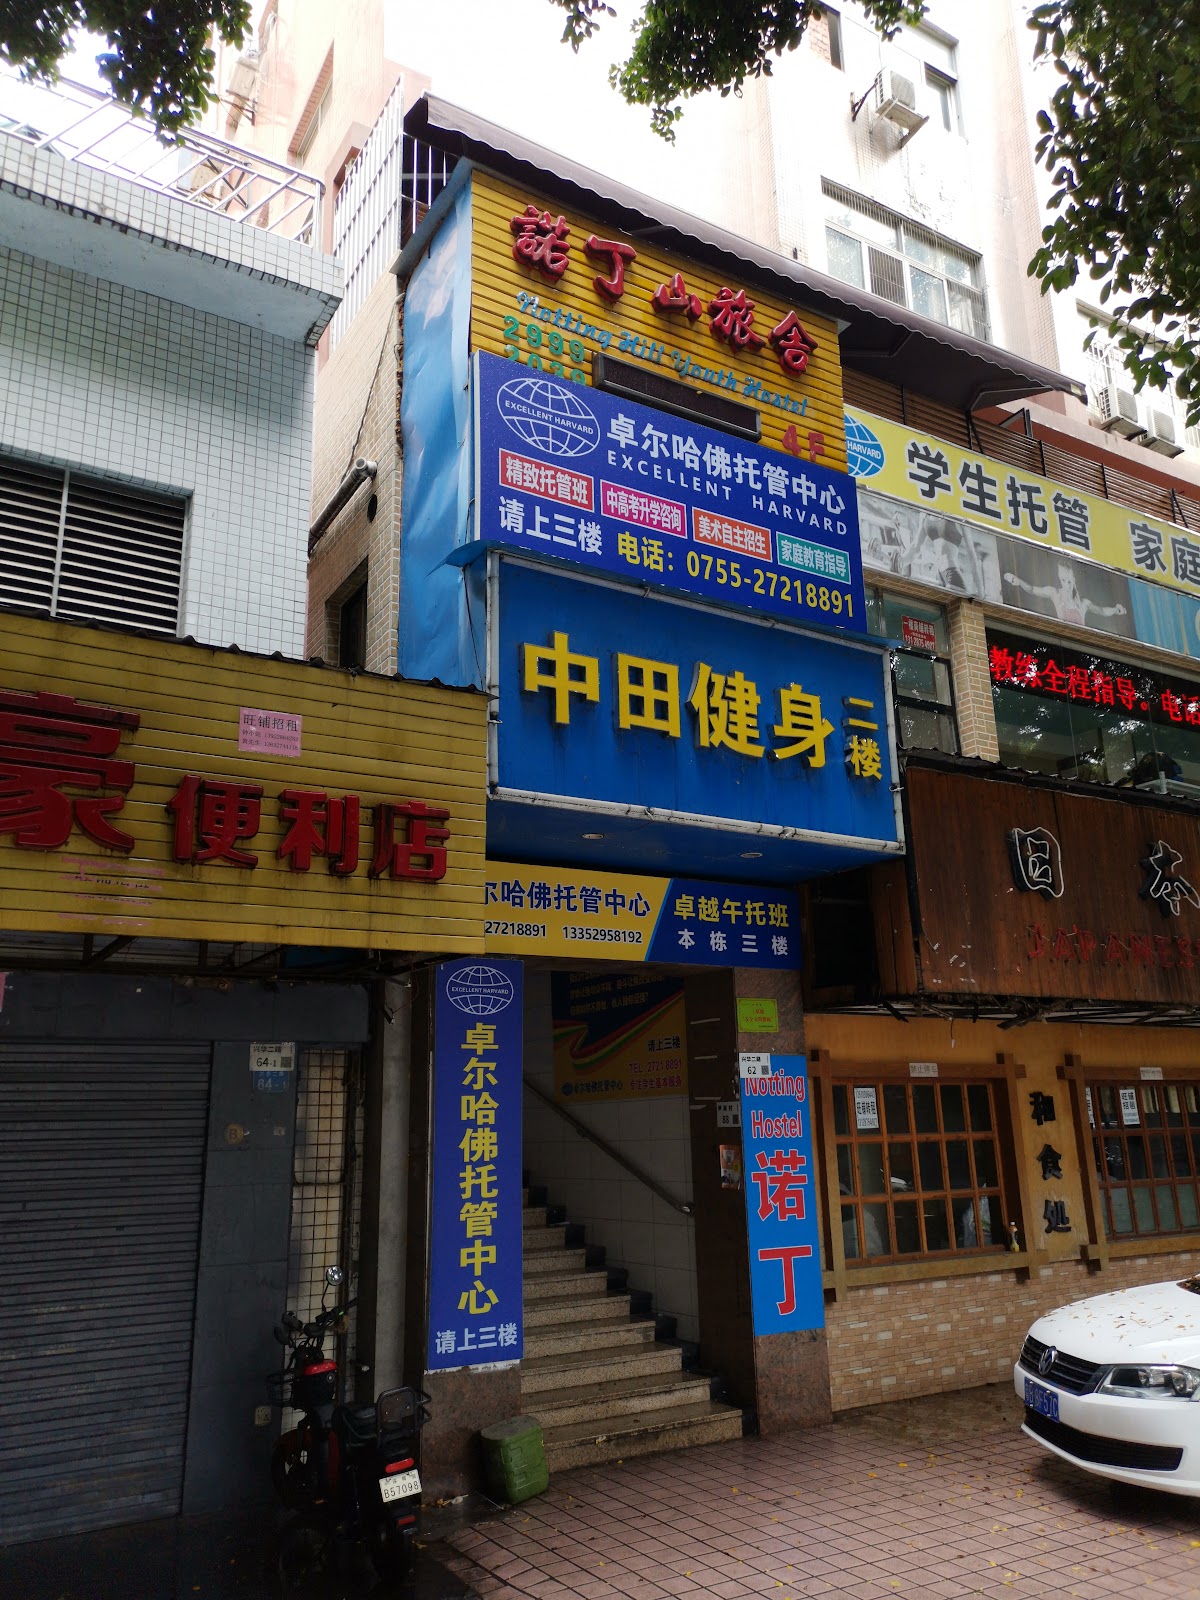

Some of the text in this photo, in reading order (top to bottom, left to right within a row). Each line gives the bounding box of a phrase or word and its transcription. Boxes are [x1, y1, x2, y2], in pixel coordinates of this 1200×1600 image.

[503, 315, 585, 363] 2999
[517, 290, 810, 417] Notting Hill Youth Hostel
[504, 399, 594, 437] EXCELLENT HARVARD
[606, 412, 847, 516] 卓尔哈佛托管中心
[781, 424, 826, 463] 4F
[847, 440, 882, 460] HARVARD
[505, 455, 589, 506] 精致托管班
[607, 449, 848, 536] EXCELLENT HARVARD
[905, 440, 1093, 551] 学生托管
[498, 495, 603, 556] 请上三楼
[606, 486, 682, 532] 中高考升学咨询
[698, 513, 768, 556] 美术自主招生
[780, 538, 848, 578] 家庭教育指导
[520, 629, 835, 769] 中田健身
[243, 714, 298, 732] 旺铺招租
[844, 696, 883, 781] 二楼
[167, 773, 451, 882] 便利店
[485, 920, 644, 945] 27218891 13352958192
[673, 893, 790, 930] 卓越午托班
[1025, 922, 1200, 970] JAPANES
[482, 987, 509, 995] HARVARD
[256, 1056, 277, 1068] 64-1
[647, 1035, 682, 1053] 请上三楼
[745, 1068, 806, 1103] Notting
[747, 1066, 757, 1075] 62
[750, 1109, 803, 1140] Hostel
[456, 1021, 500, 1316] 卓尔哈佛托管中心
[751, 1148, 814, 1317] 诺丁
[434, 1323, 519, 1355] 请上三楼
